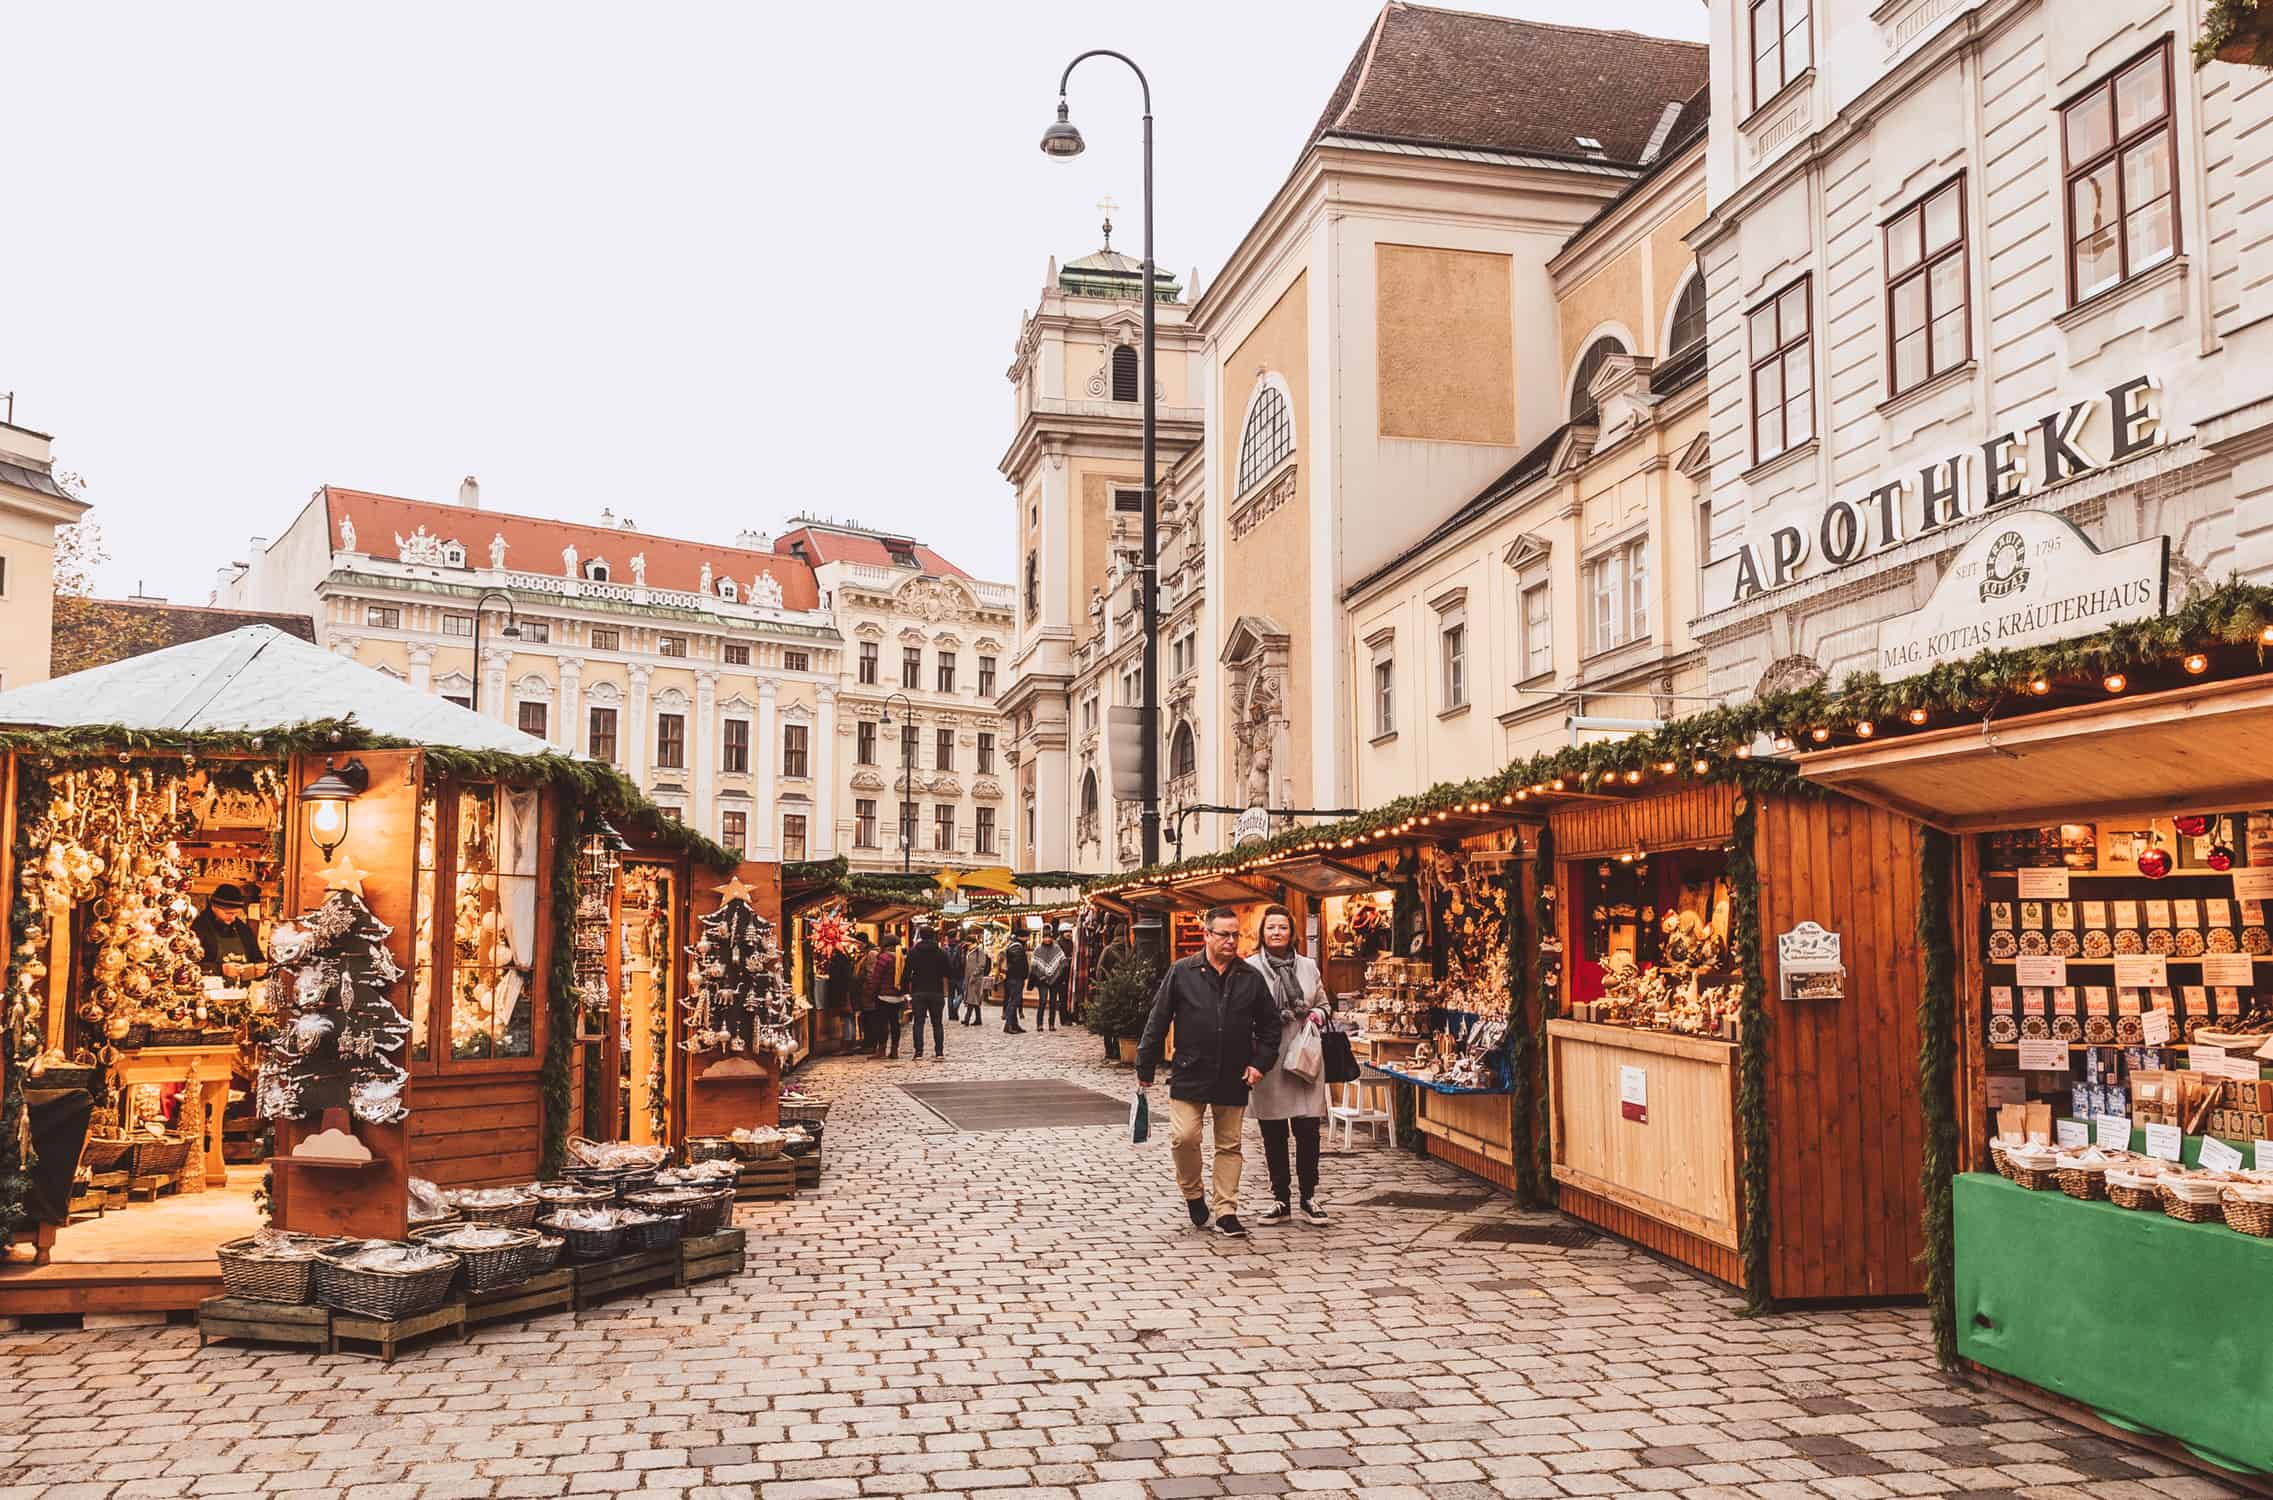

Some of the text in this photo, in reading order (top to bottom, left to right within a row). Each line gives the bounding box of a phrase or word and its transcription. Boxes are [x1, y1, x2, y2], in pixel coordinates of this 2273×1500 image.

[1733, 374, 2165, 601] APOTHEKE
[1956, 561, 1978, 578] SEIT
[1983, 572, 2025, 595] KOTTAS
[1884, 578, 2151, 669] MAG. KOTTAS KRÄUTERHAUS
